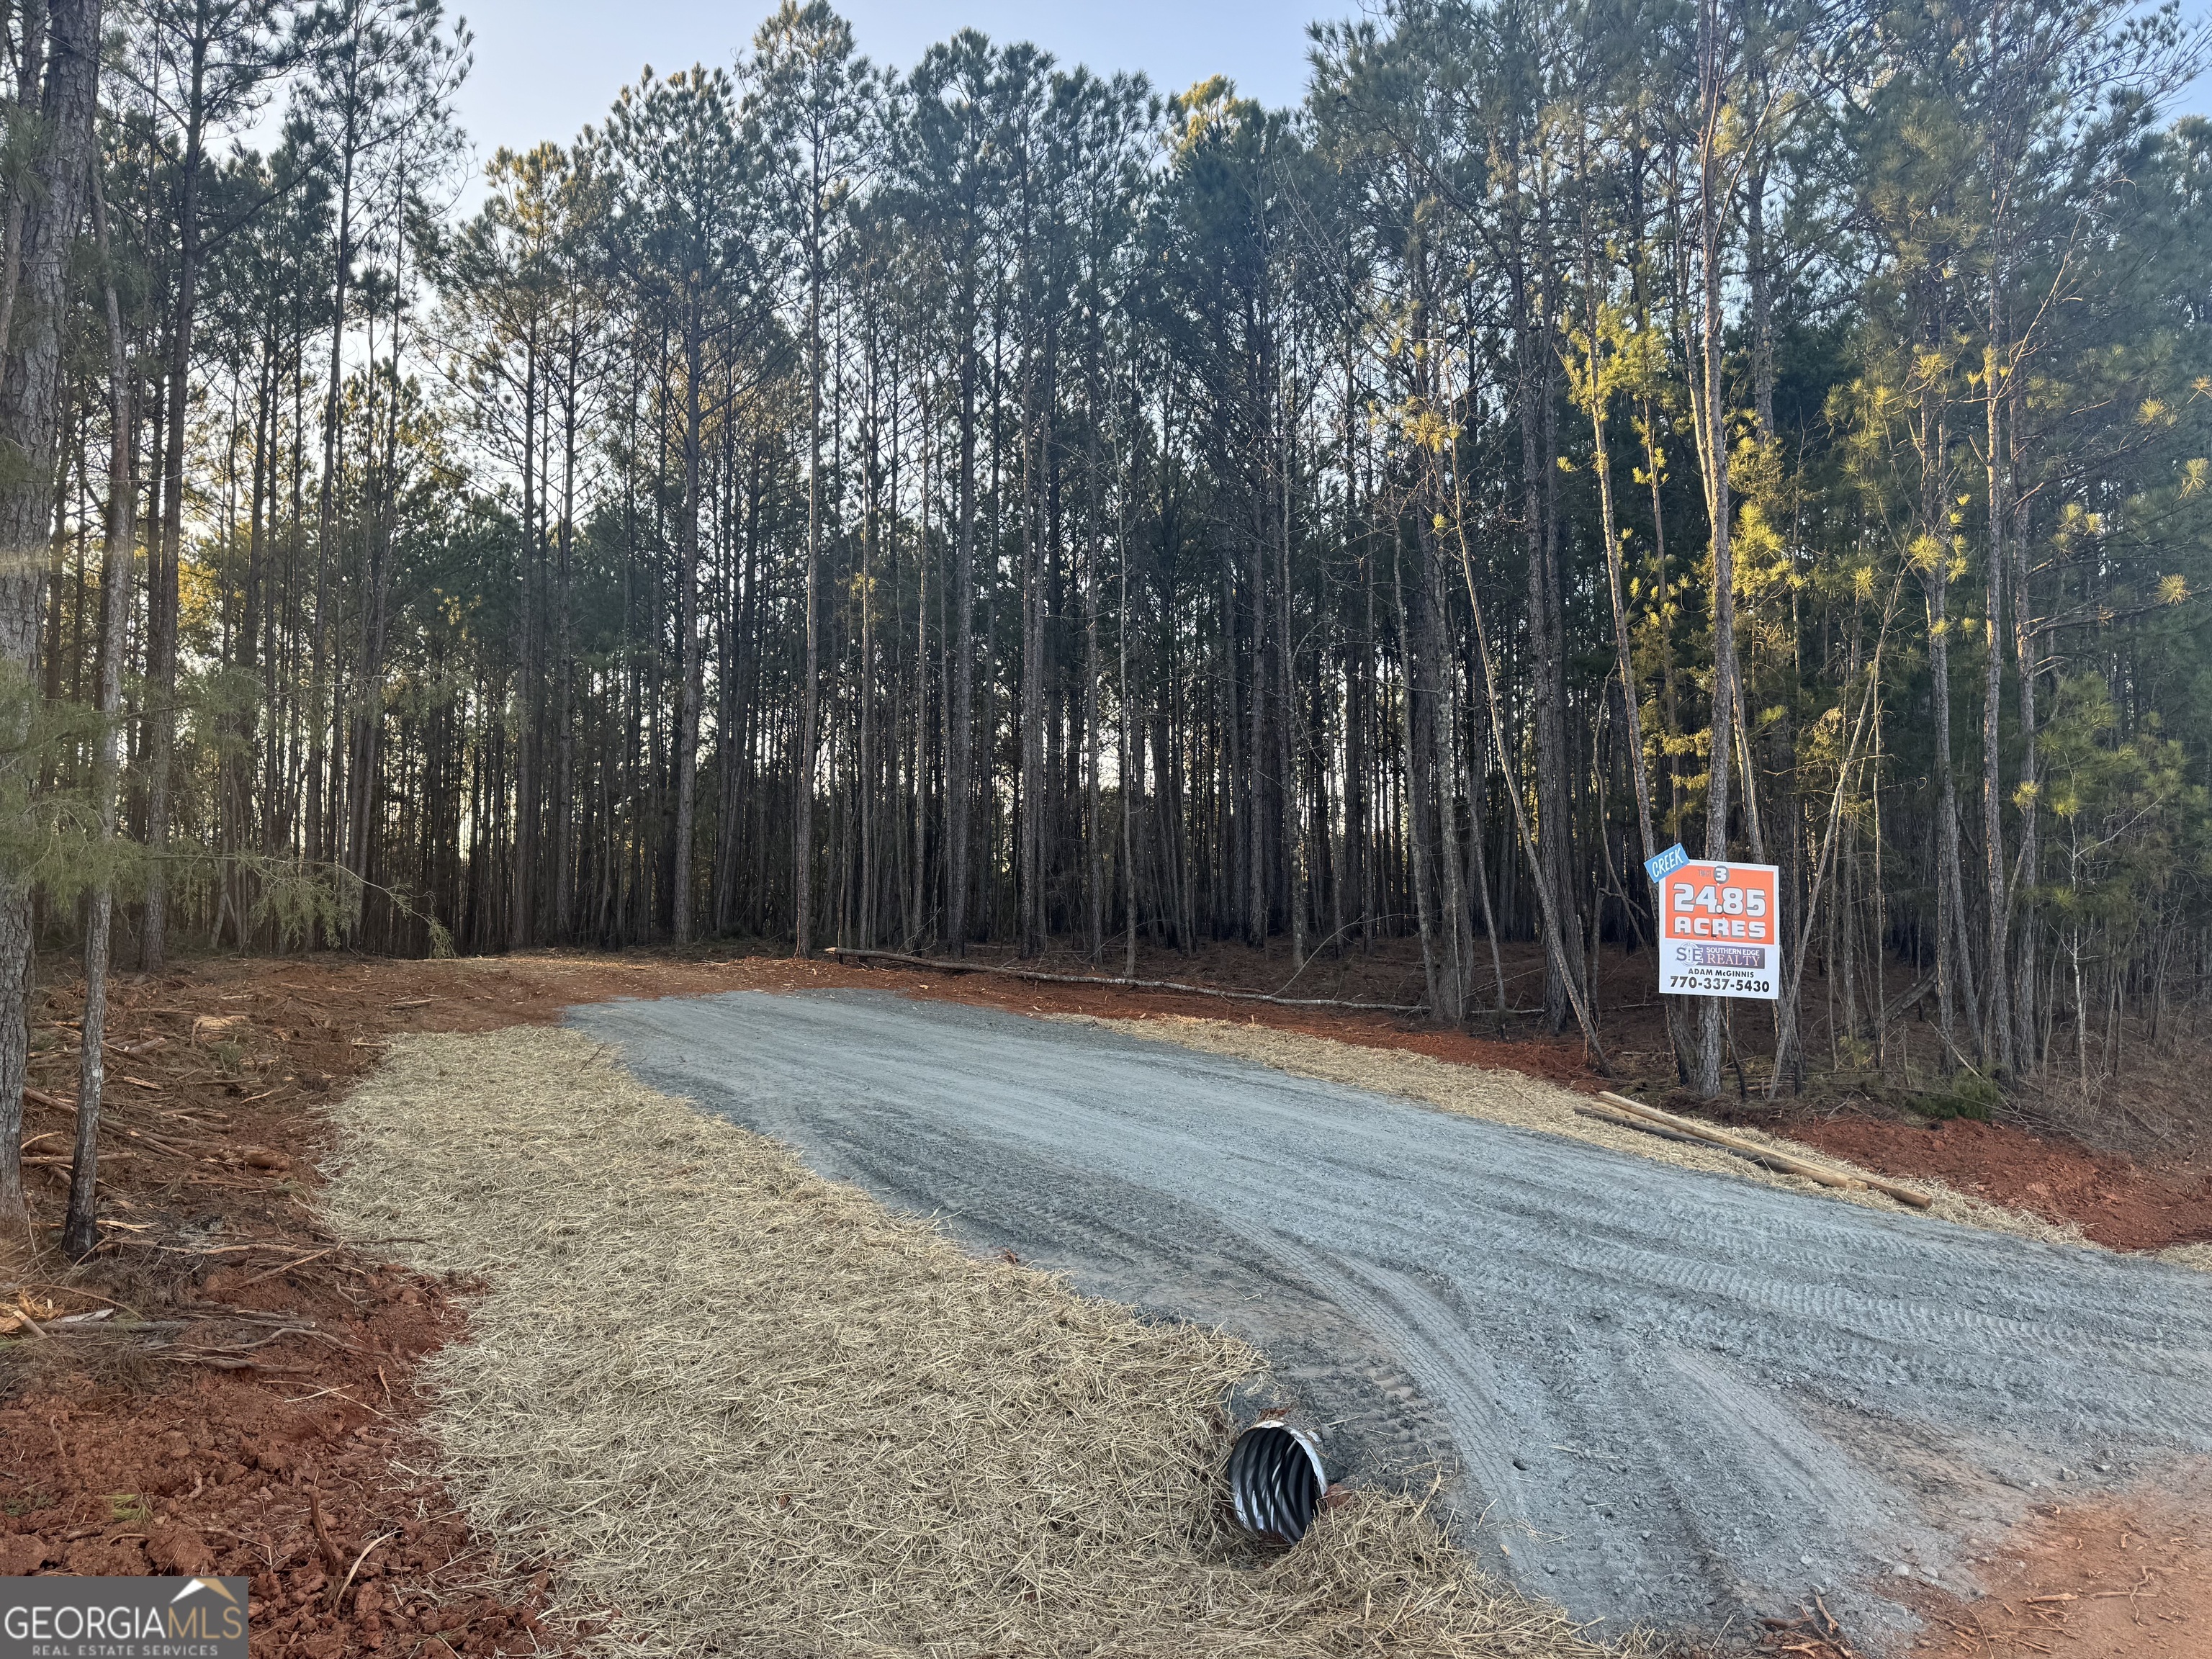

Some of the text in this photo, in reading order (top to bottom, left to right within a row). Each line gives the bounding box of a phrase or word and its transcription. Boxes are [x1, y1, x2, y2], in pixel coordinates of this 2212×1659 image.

[1651, 847, 1684, 878] CREEK
[1715, 867, 1727, 881] 3
[1673, 883, 1766, 917] 24.85
[1673, 916, 1766, 940] ACRES
[1707, 953, 1761, 966] REALTY
[1670, 976, 1770, 992] 770-337-5430
